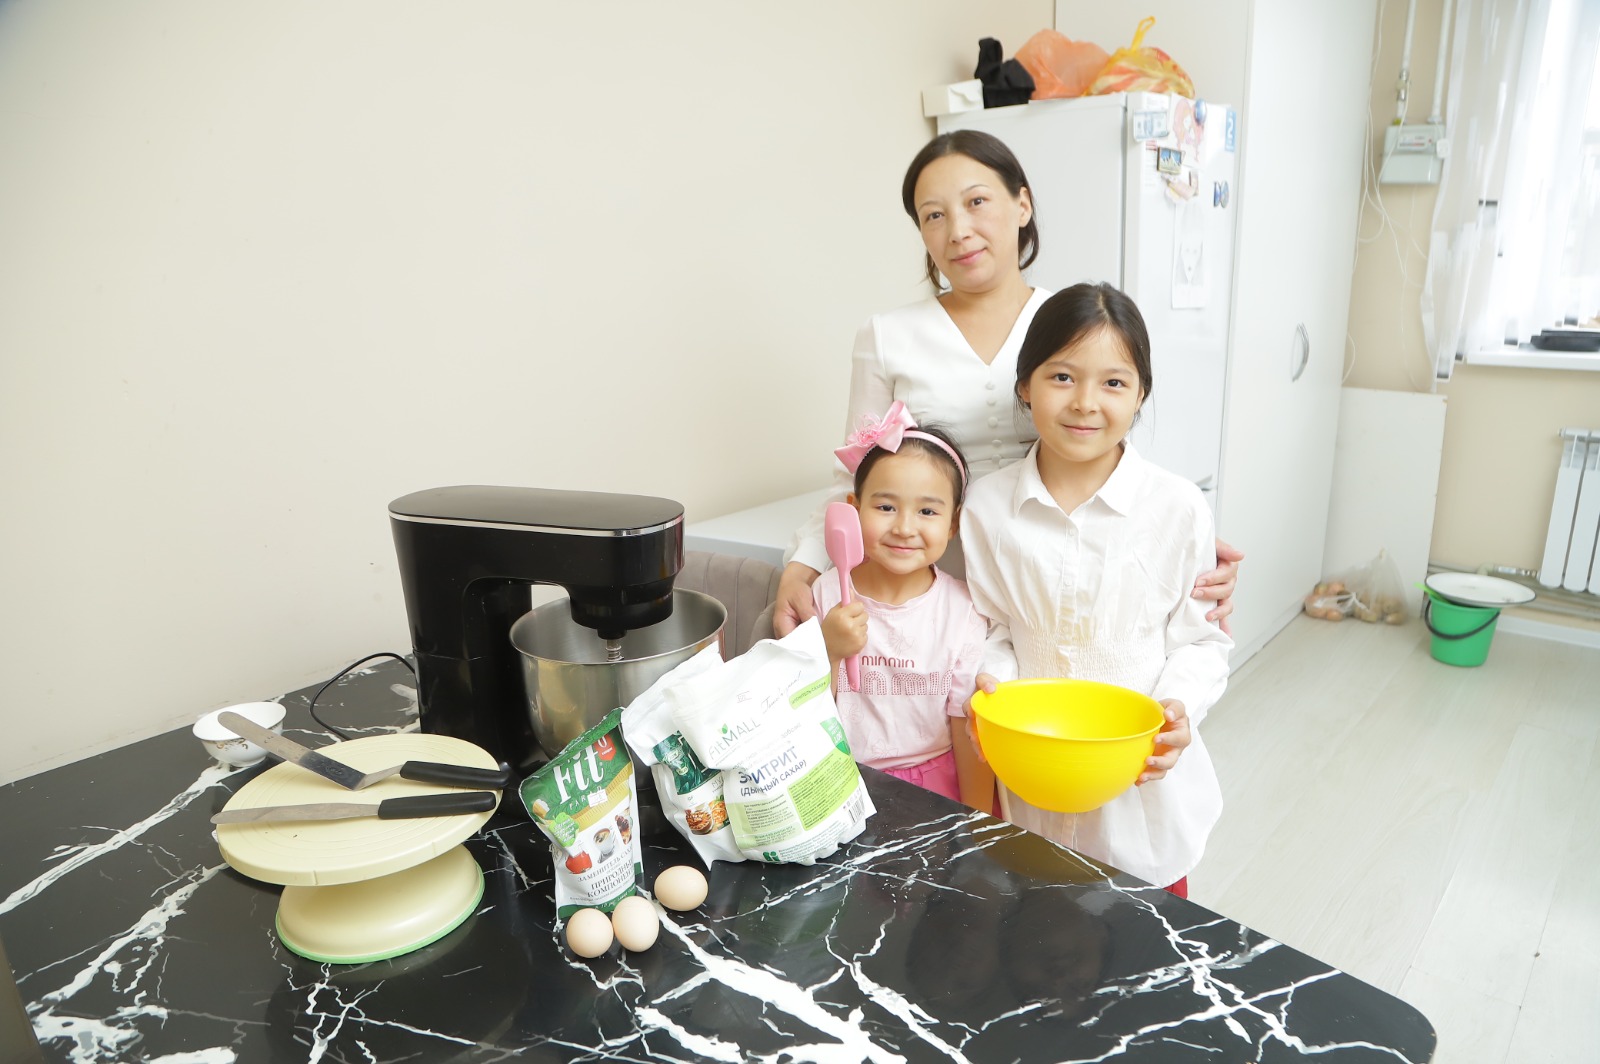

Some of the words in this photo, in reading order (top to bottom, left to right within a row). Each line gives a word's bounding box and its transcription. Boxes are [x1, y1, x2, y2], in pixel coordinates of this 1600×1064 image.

[553, 744, 604, 805] Fit
[738, 746, 797, 785] ЭИТРИТ
[591, 859, 633, 890] ПРИРОДНЫ
